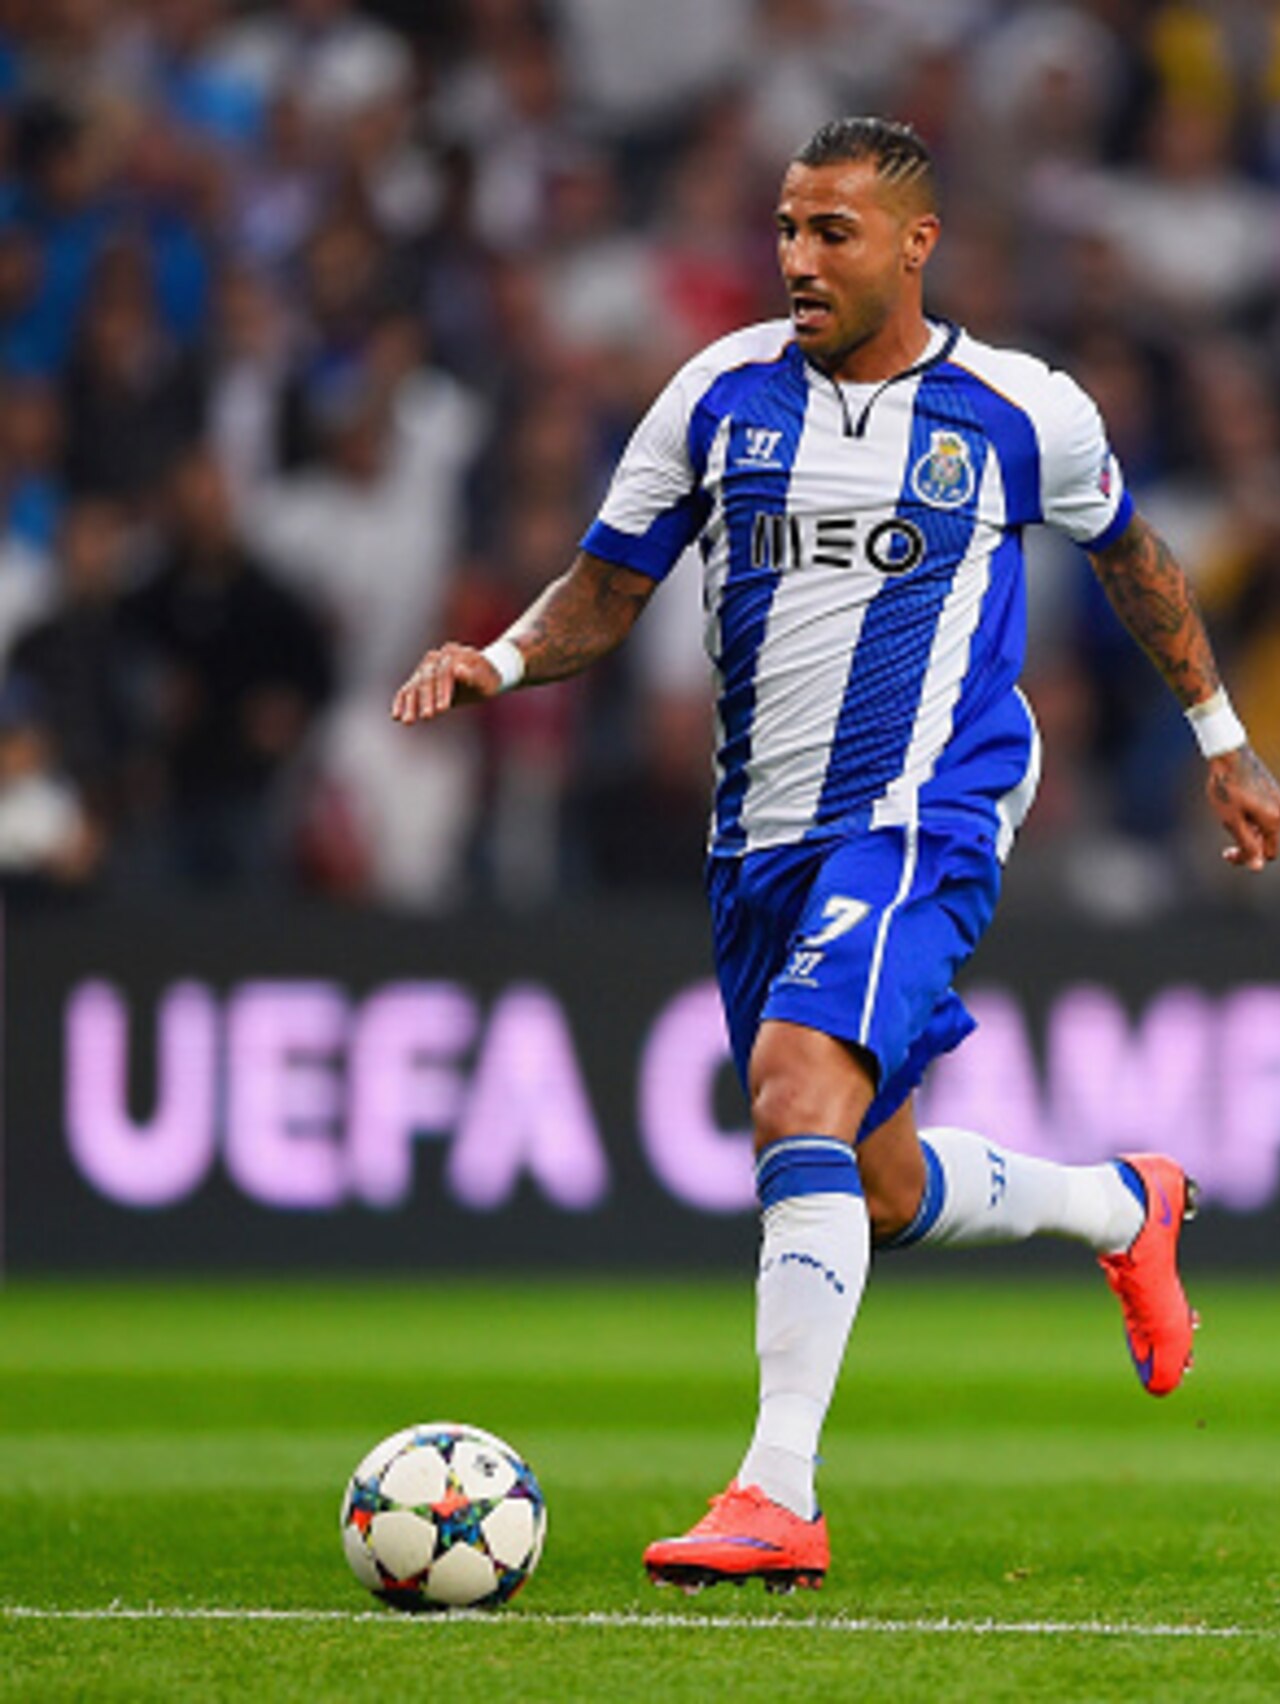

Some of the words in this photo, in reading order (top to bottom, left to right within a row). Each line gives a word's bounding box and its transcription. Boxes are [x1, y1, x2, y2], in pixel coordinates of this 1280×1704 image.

[753, 513, 925, 574] MEO
[803, 895, 871, 946] 7
[65, 980, 607, 1209] UEFA
